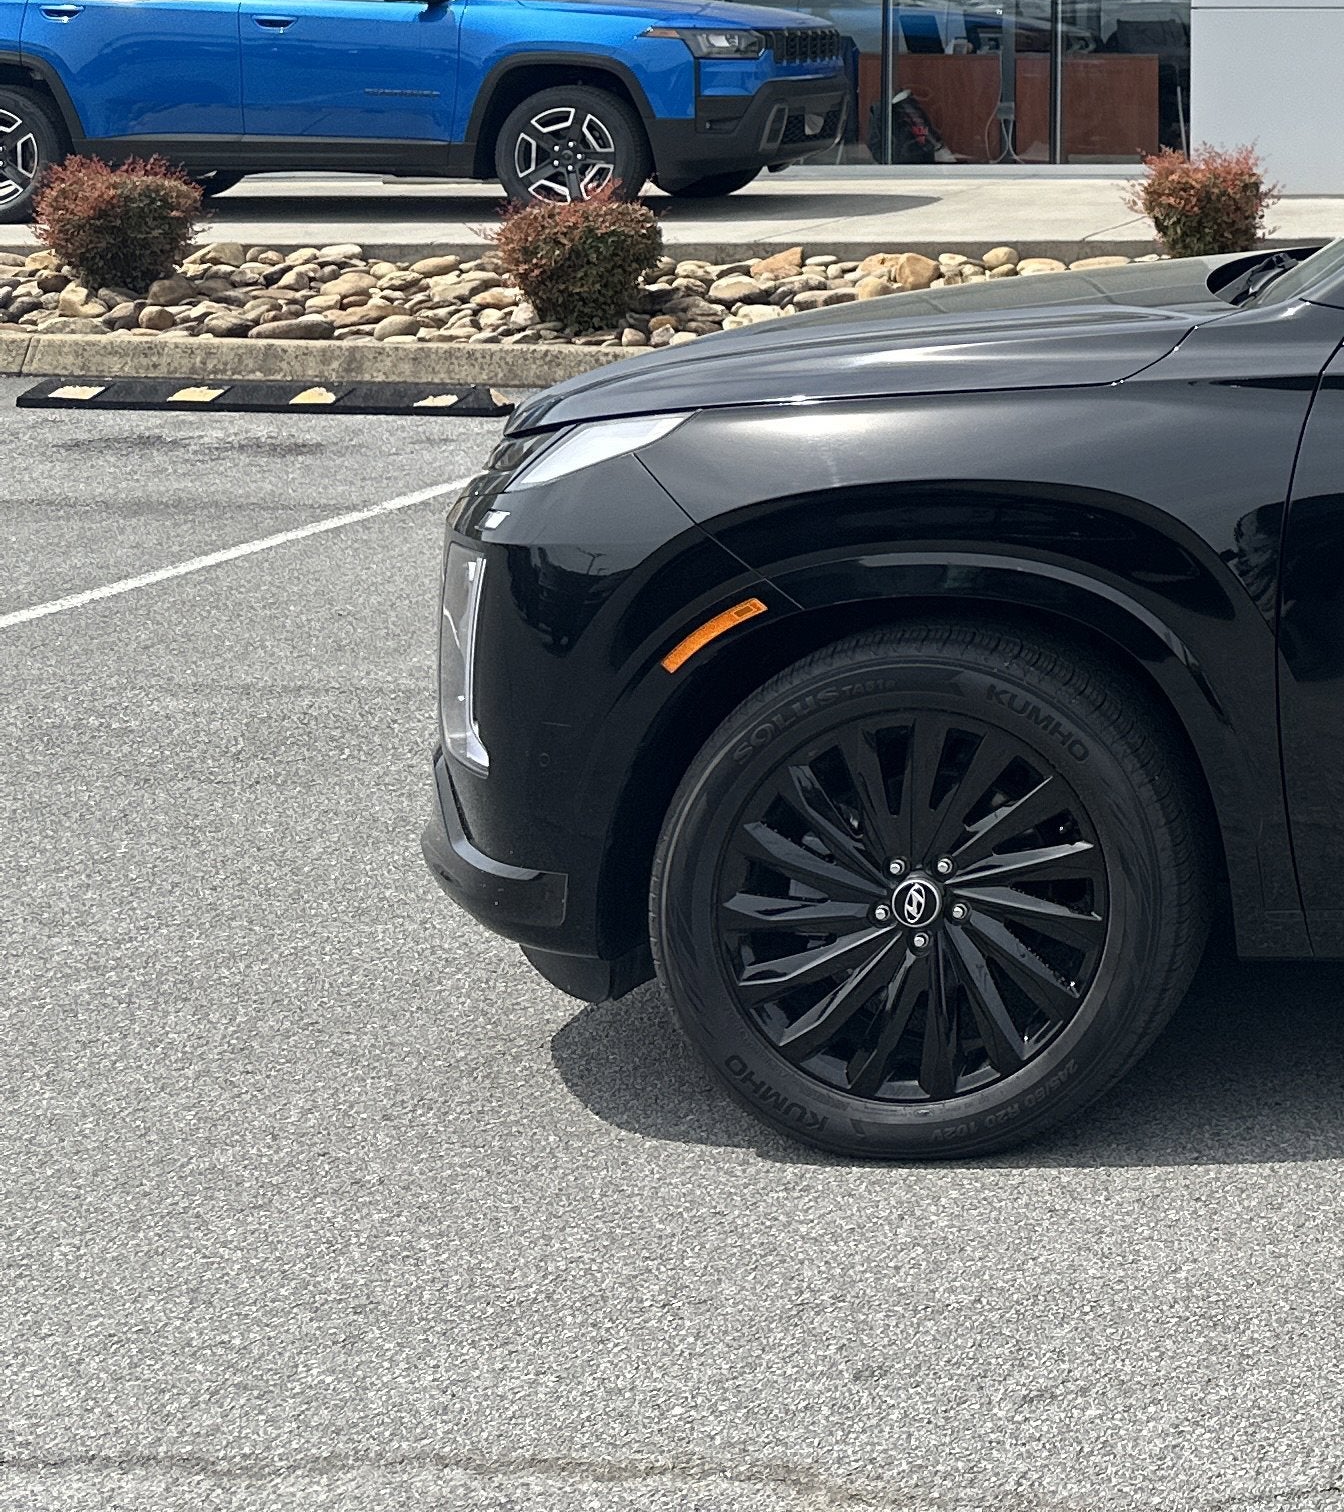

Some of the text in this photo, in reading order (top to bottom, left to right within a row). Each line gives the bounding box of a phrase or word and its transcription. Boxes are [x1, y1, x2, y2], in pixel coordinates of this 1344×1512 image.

[733, 686, 840, 766] SOLUS
[986, 684, 1089, 762] KUMHO
[724, 1054, 830, 1132] KUMHO
